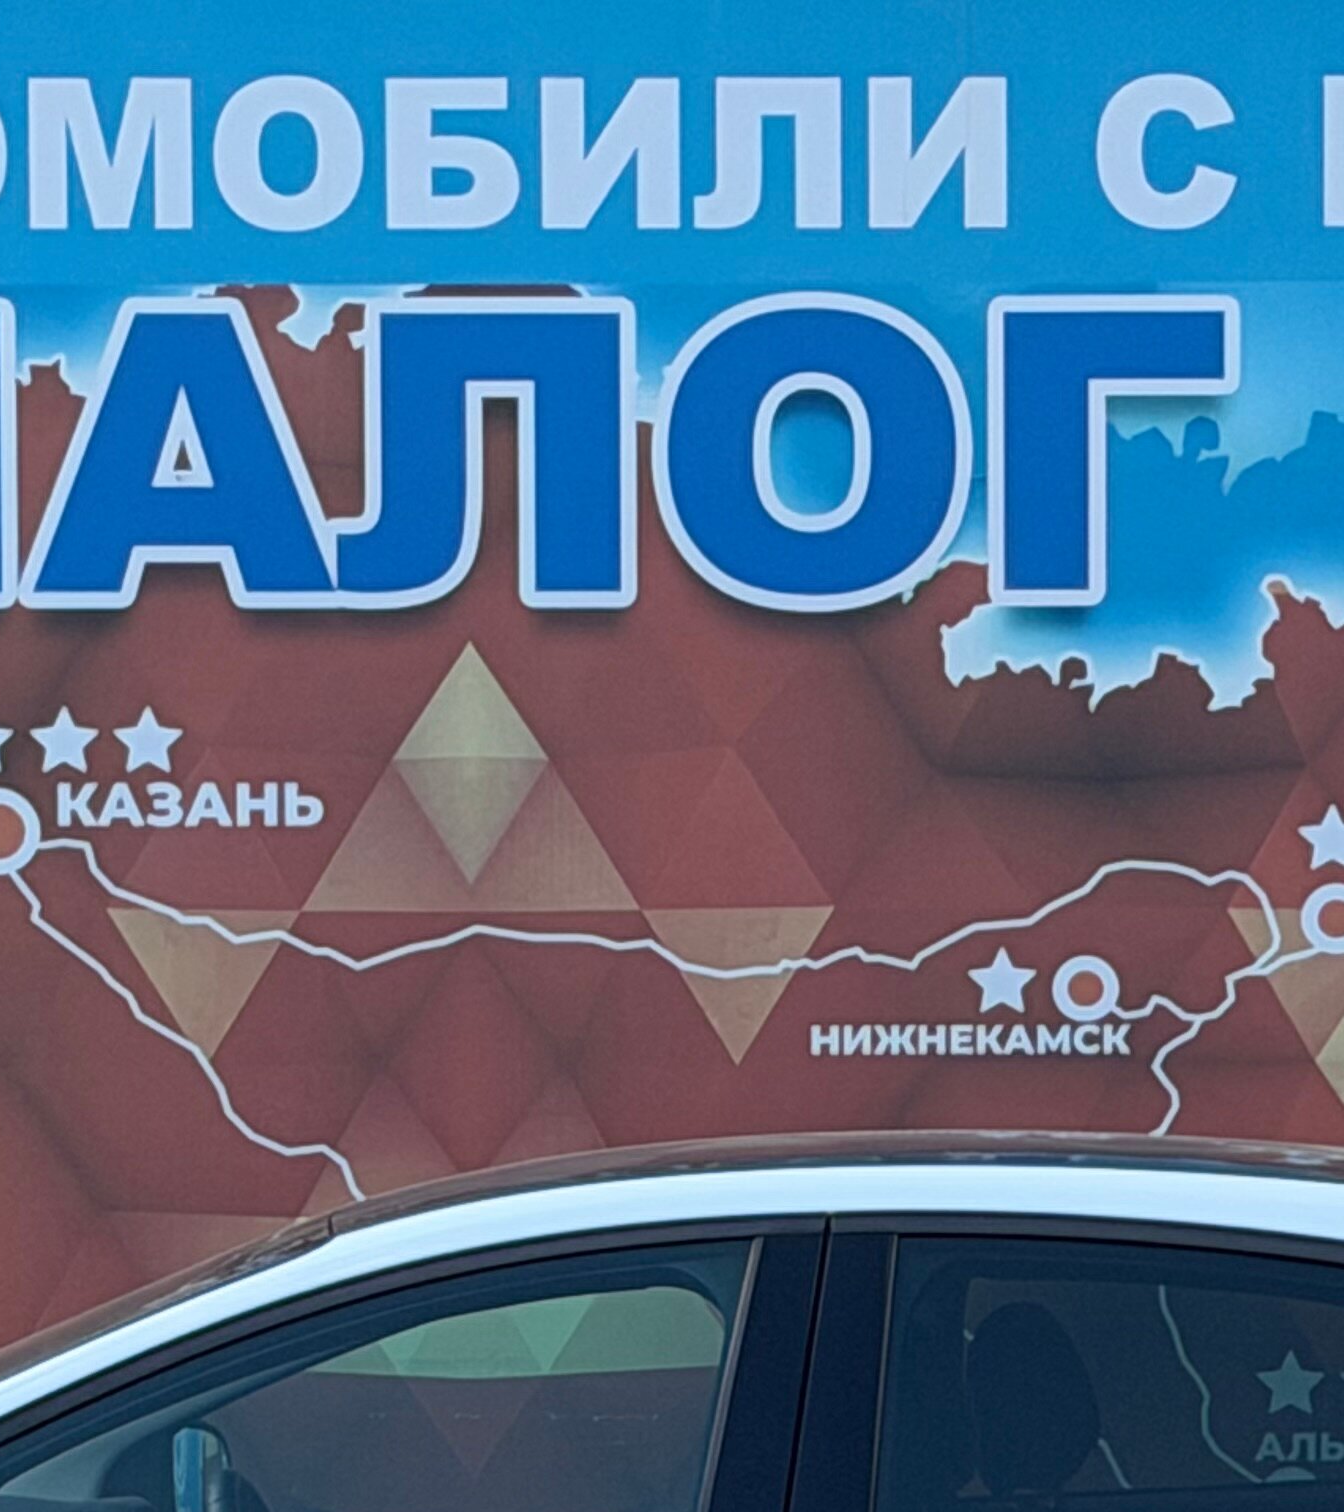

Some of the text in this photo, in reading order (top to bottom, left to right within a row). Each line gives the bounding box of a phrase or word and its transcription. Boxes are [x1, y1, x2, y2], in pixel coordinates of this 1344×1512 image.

[1096, 74, 1238, 229] С
[56, 781, 325, 828] КАЗАНЬ
[810, 1022, 1131, 1057] НИЖНЕКАМСК
